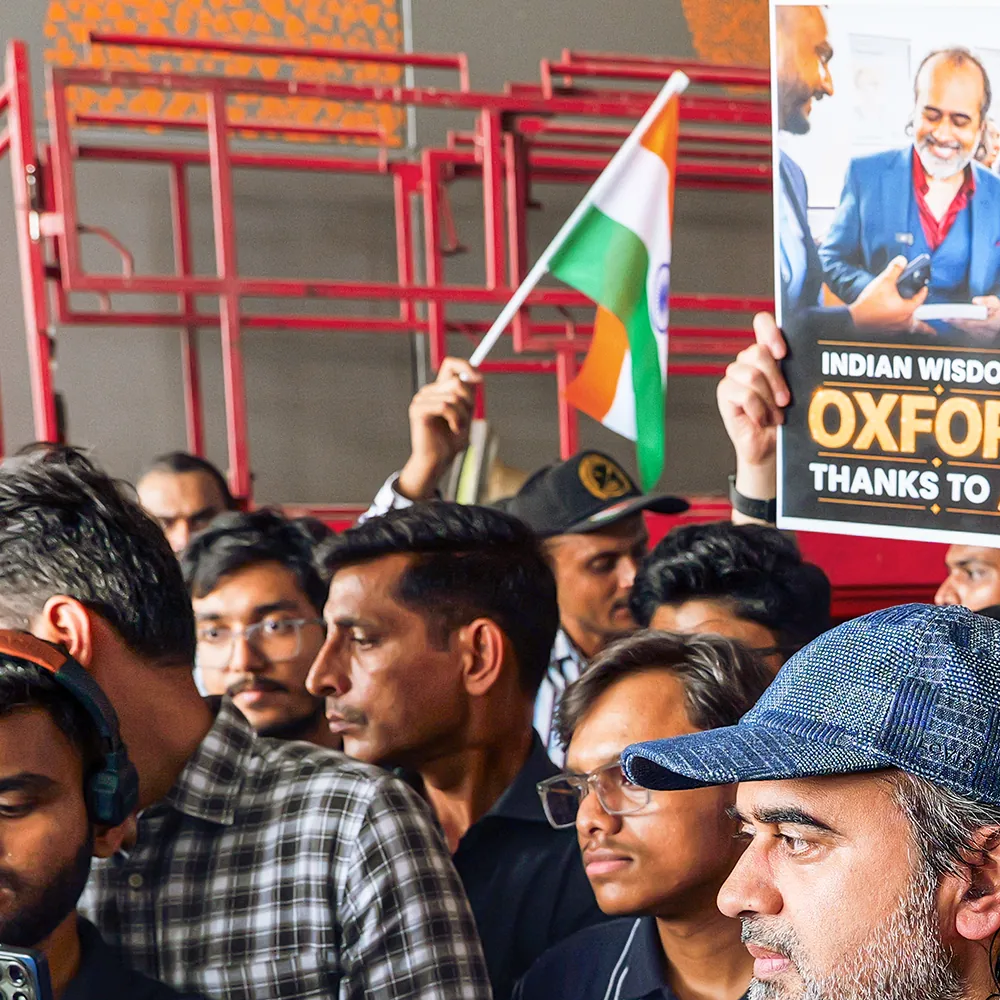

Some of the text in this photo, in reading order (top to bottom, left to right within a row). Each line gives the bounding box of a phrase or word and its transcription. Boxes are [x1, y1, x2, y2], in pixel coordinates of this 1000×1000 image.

[821, 351, 912, 380] INDIAN
[808, 462, 940, 501] THANKS
[946, 472, 991, 504] TO
